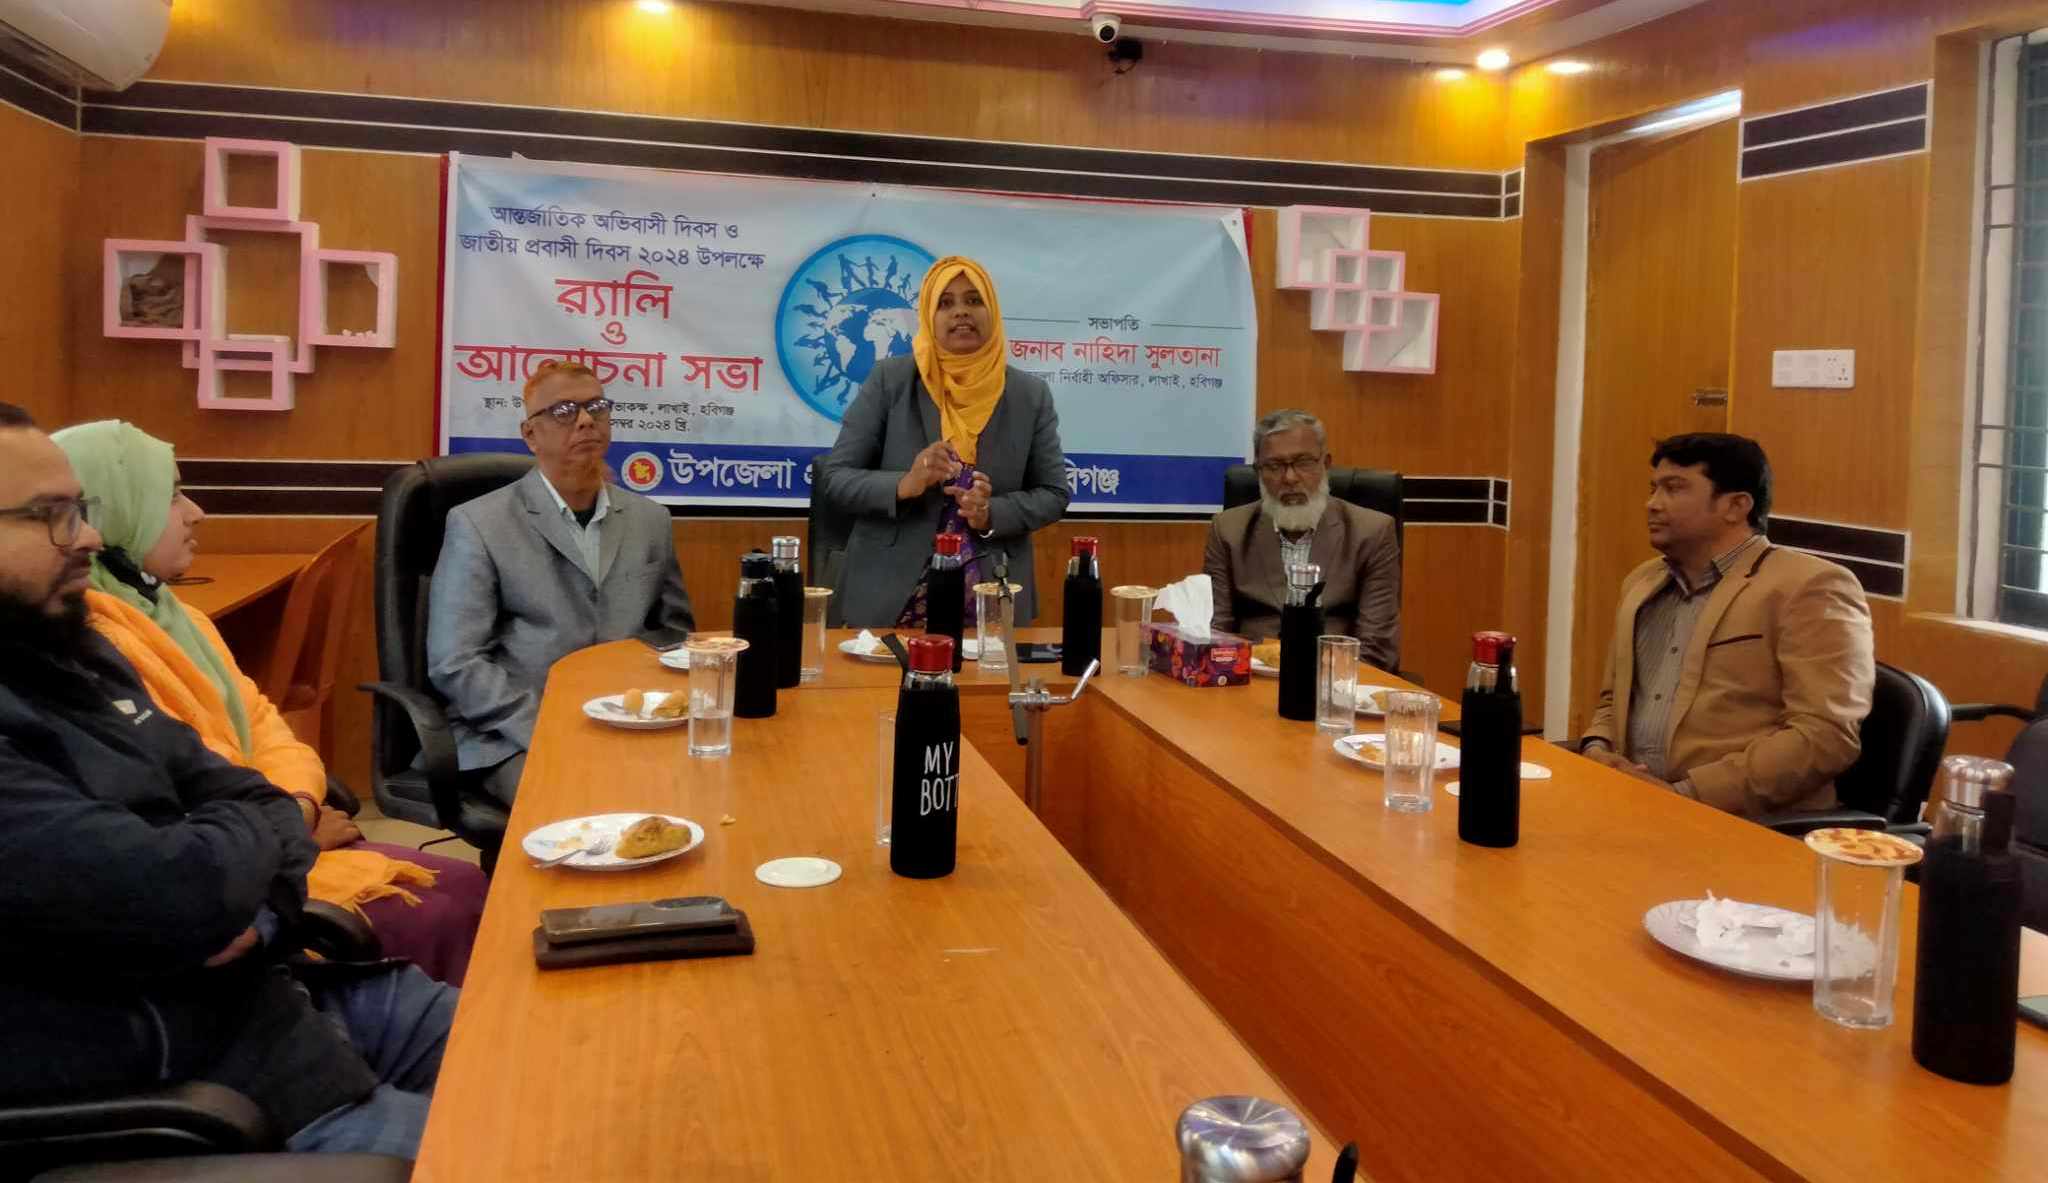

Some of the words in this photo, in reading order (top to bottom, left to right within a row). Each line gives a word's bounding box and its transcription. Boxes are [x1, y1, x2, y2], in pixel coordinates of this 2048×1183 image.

[490, 205, 587, 227] আন্তর্জাতিক
[592, 210, 666, 235] অভিবাসী
[674, 214, 718, 238] দিবস
[725, 223, 739, 239] ও
[459, 230, 520, 252] জাতীয়
[524, 235, 580, 258] প্রবাসী
[585, 238, 632, 263] দিবস
[639, 247, 689, 267] ২০২৪
[696, 246, 767, 269] উপলক্ষে
[601, 321, 627, 345] ও
[1088, 314, 1142, 332] সভাপতি
[1008, 339, 1066, 361] জনাব
[1072, 336, 1139, 364] নাহিদা
[1144, 344, 1223, 369] সুলতানা
[681, 354, 764, 391] সভা
[1059, 369, 1094, 385] নির্বাহী
[667, 448, 797, 489] উপজেলা
[1064, 458, 1120, 495] বিগঞ্জ
[924, 741, 954, 775] MY
